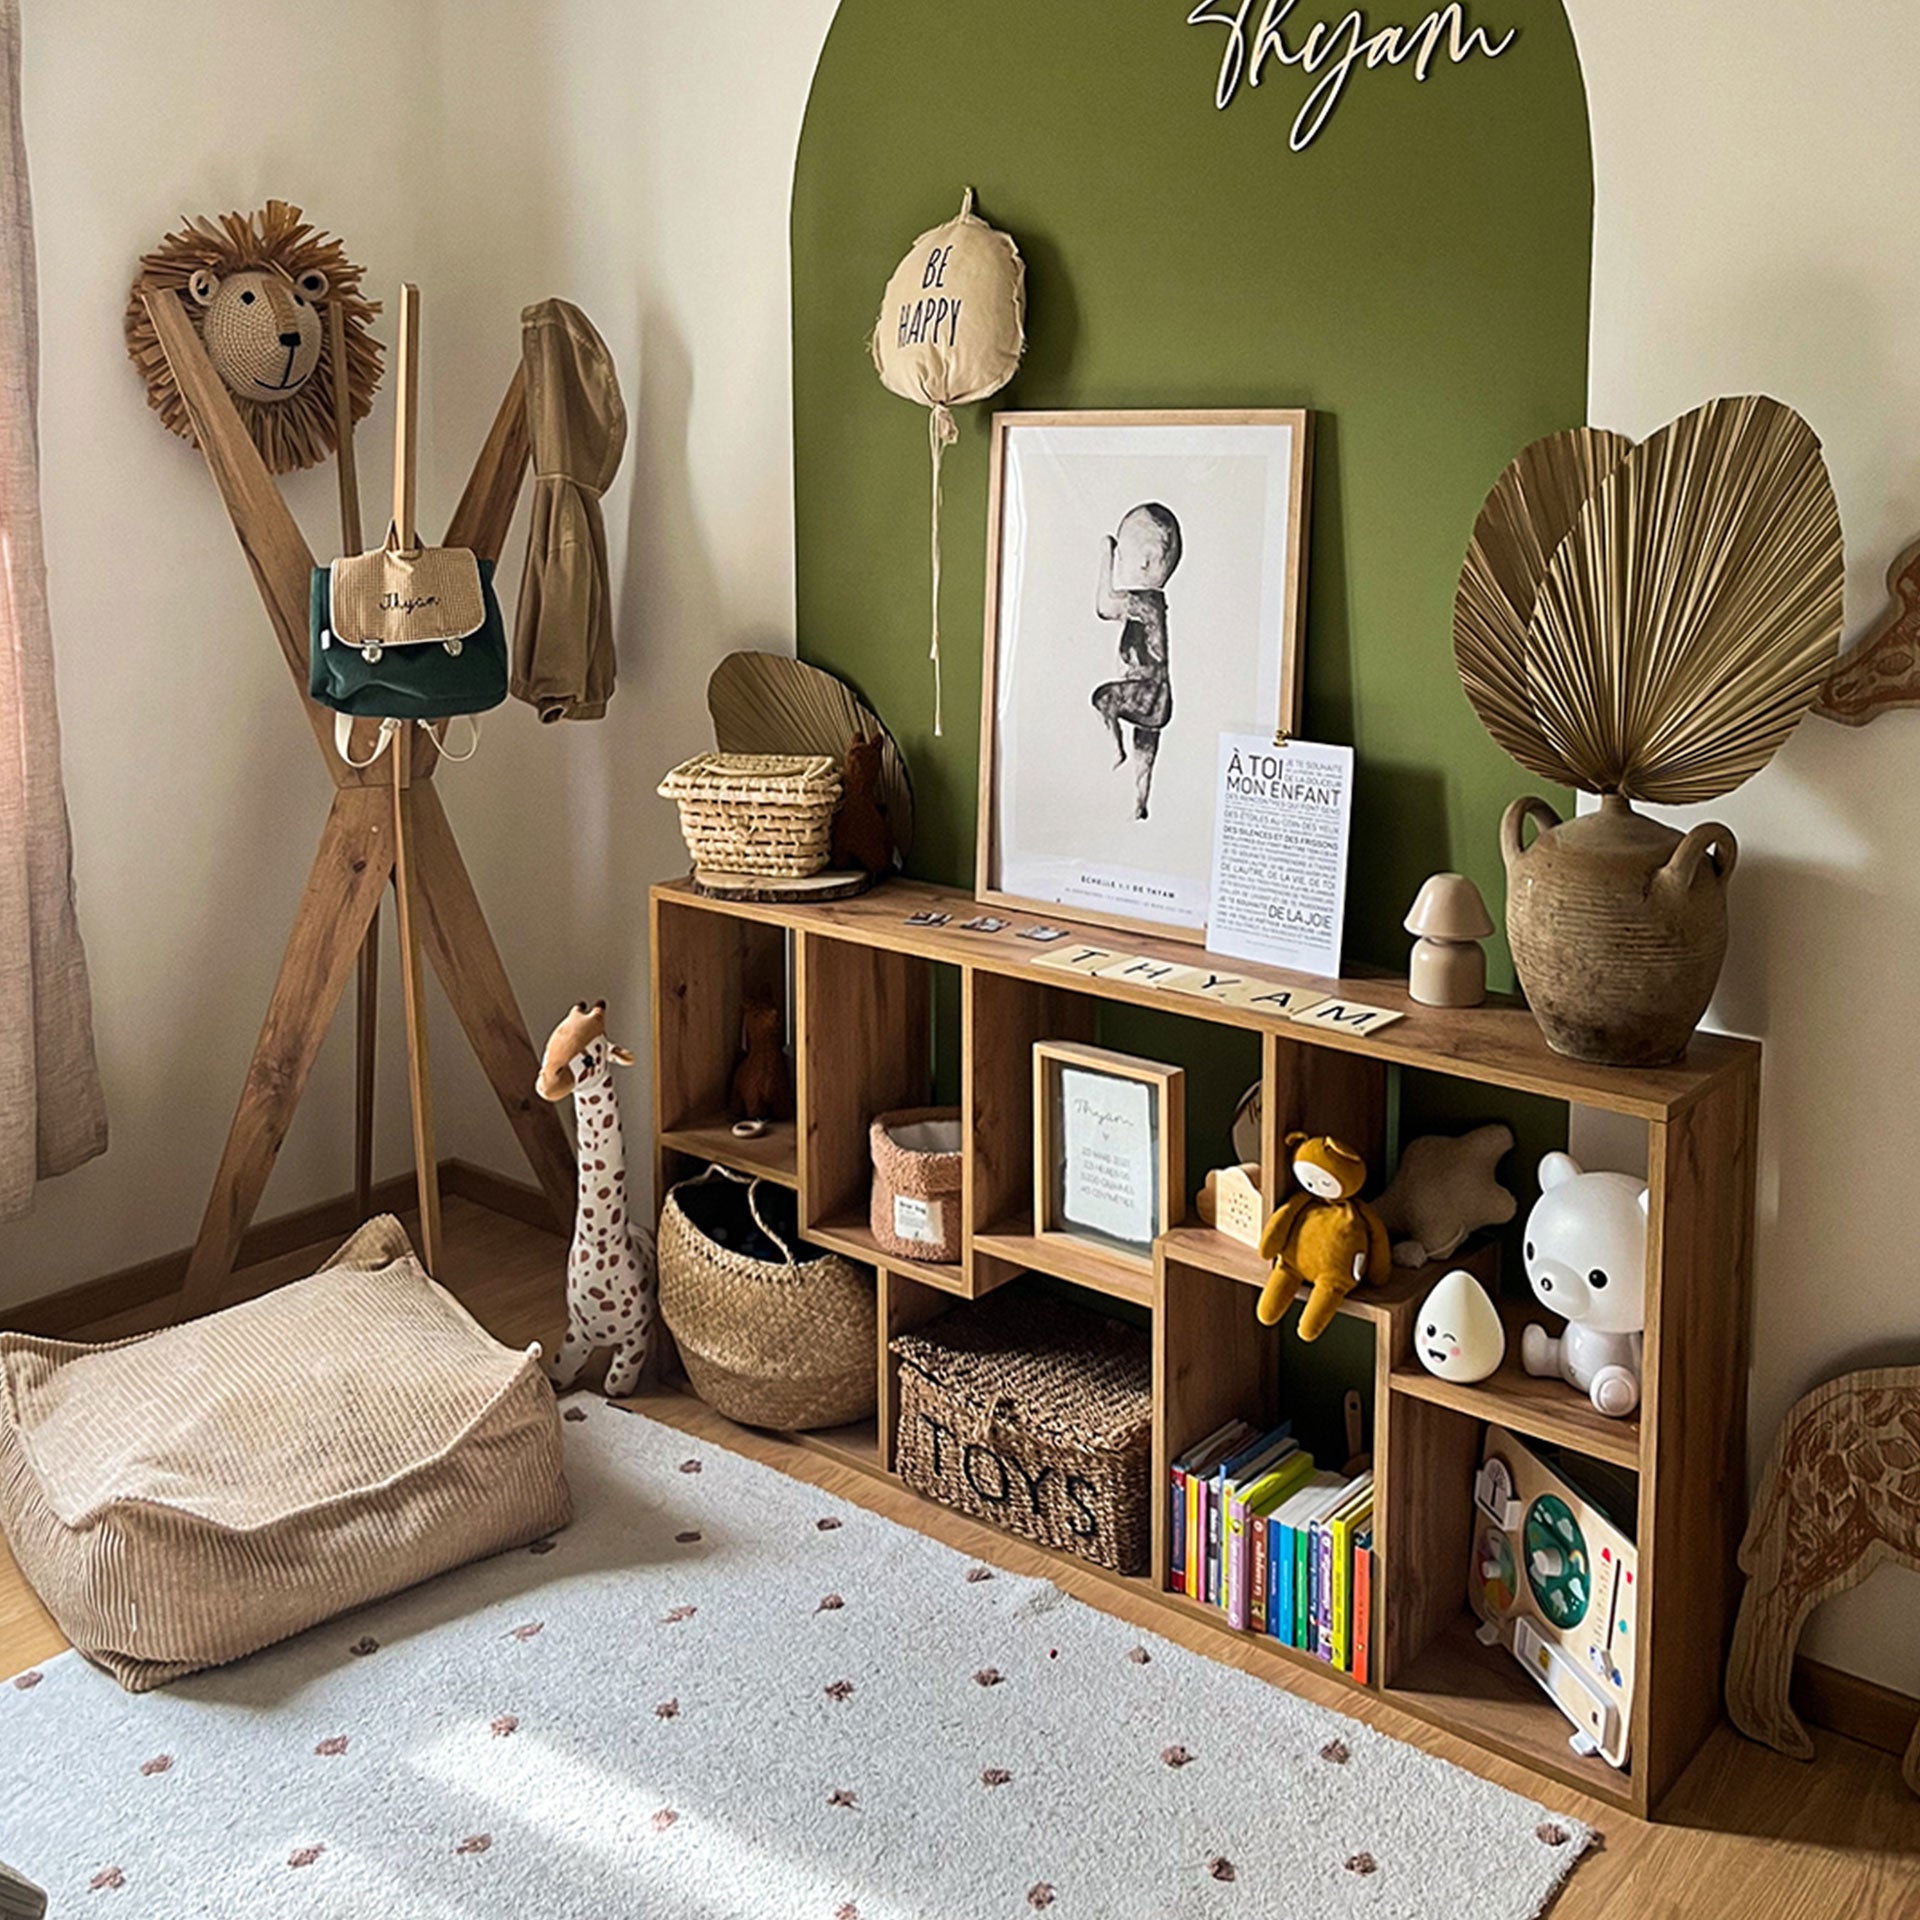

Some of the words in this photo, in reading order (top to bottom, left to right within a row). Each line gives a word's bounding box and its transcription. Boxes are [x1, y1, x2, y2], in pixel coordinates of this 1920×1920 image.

[1187, 0, 1515, 151] Thyam
[922, 245, 953, 289] BE
[898, 297, 961, 348] HAPPY
[1228, 747, 1243, 774] À
[1248, 754, 1283, 780] TOI
[1226, 775, 1266, 796] MON
[1270, 781, 1341, 806] ENFANT
[1268, 904, 1284, 919] DE
[1287, 908, 1303, 923] LA
[920, 1413, 1098, 1538] TOYS
